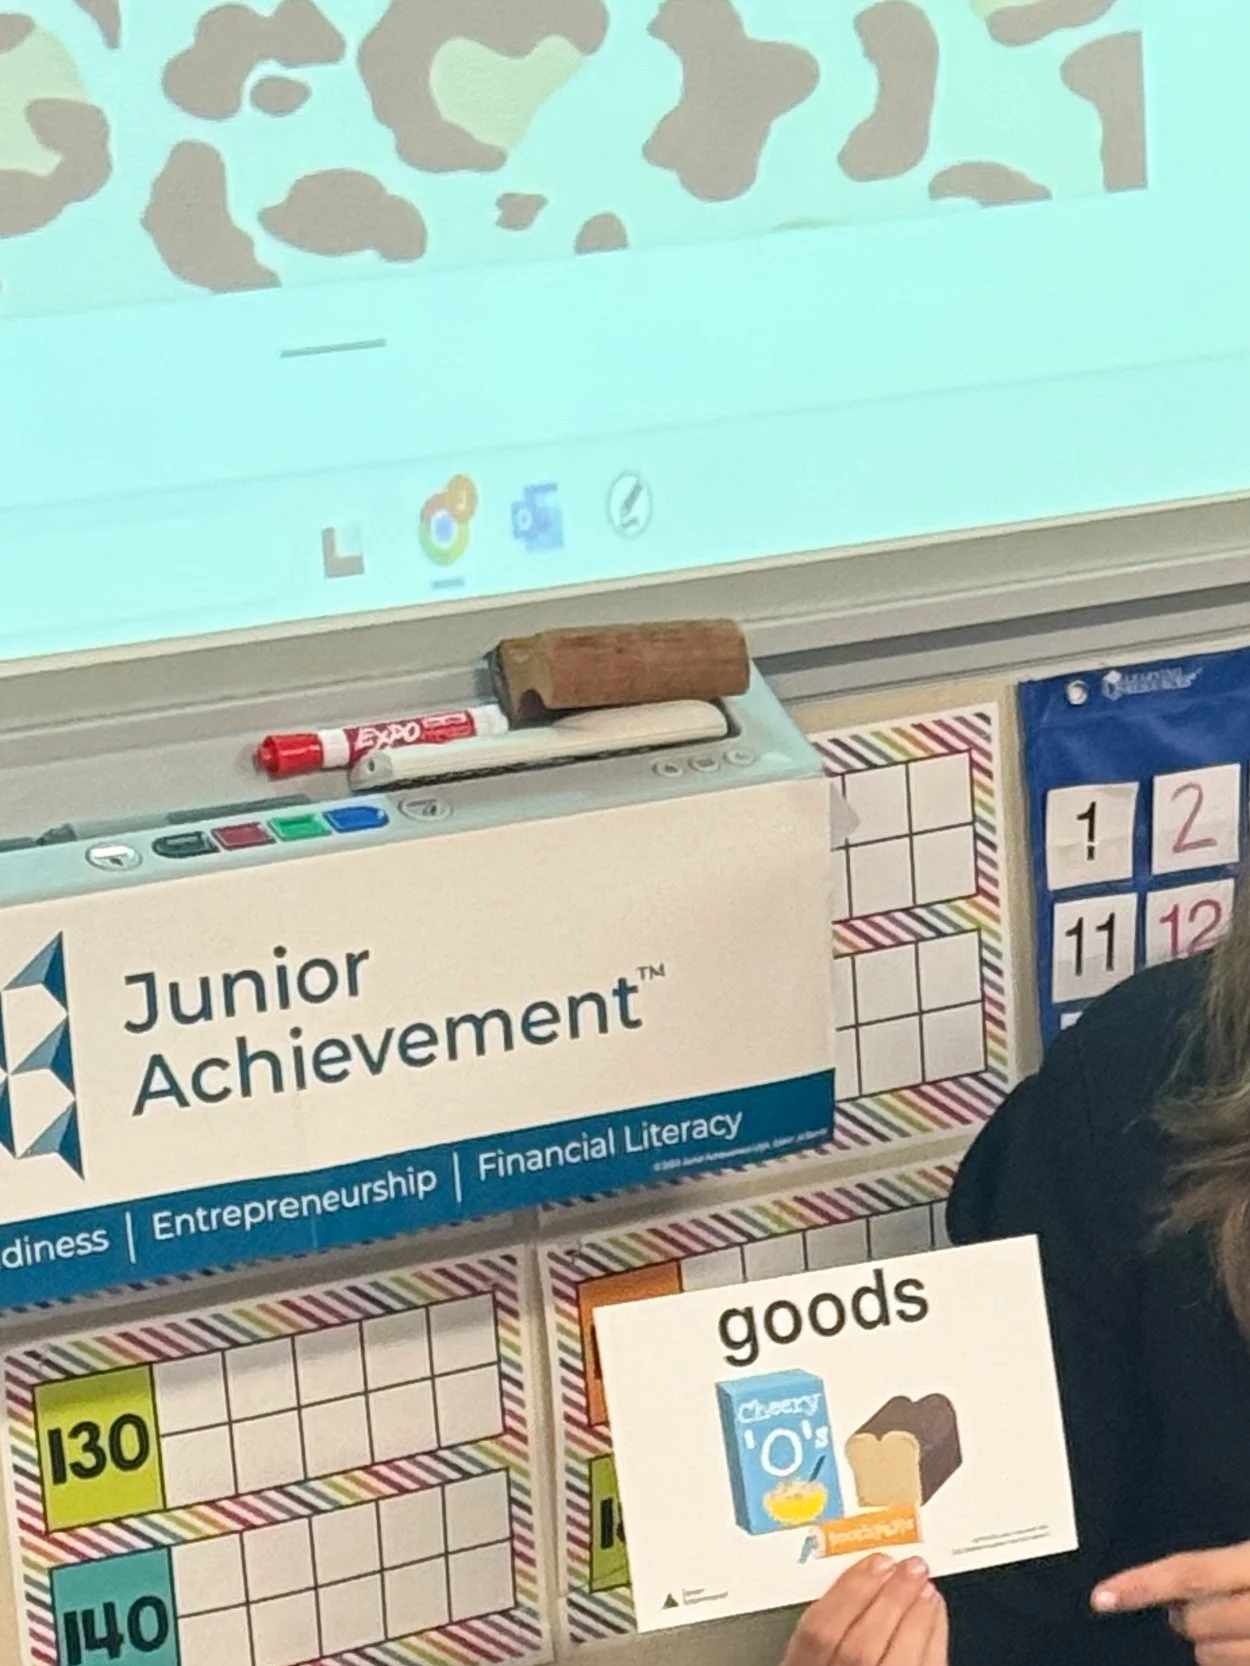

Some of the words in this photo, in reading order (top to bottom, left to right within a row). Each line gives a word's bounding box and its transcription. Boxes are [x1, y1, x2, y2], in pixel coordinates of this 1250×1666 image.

[354, 721, 421, 751] EXPO
[1171, 782, 1218, 854] 2
[1065, 912, 1116, 977] 11
[1159, 898, 1222, 958] 12
[123, 945, 370, 1035] Junior
[1, 1226, 110, 1269] diness
[152, 1165, 438, 1242] Entrepreneurship
[478, 1127, 616, 1182] Financial
[624, 1111, 744, 1154] Literacy
[718, 1267, 930, 1368] goods
[48, 1413, 150, 1487] 130
